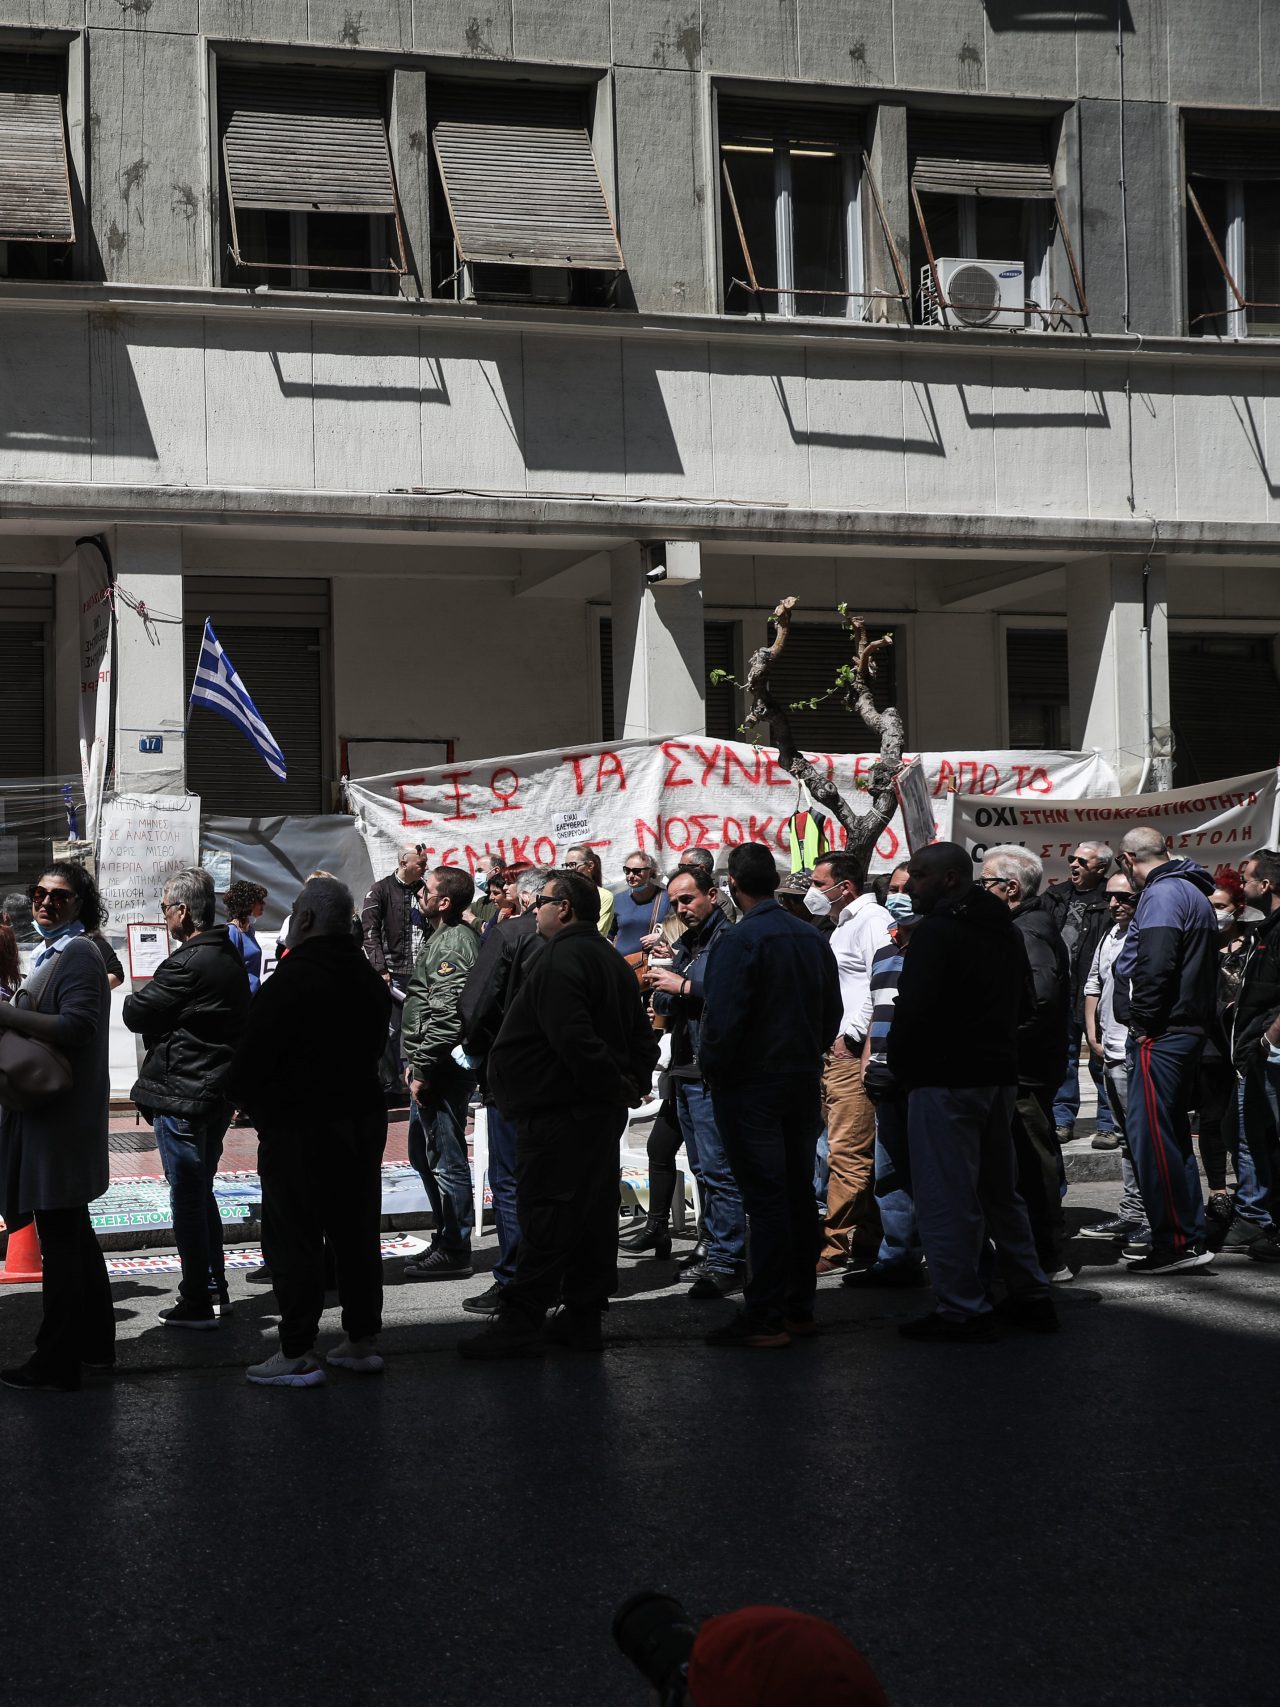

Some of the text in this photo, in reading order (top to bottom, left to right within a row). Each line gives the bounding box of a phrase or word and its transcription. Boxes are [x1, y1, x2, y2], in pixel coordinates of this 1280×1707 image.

[145, 739, 156, 749] 17
[562, 751, 627, 796] ΤΑ
[933, 759, 999, 796] ΑΠΟ
[1011, 764, 1053, 794] ΤΟ
[975, 806, 1018, 828] ΟΧΙ
[1019, 808, 1070, 825] ΣΤΗΝ
[138, 819, 169, 830] ΜΗΝΕΣ
[110, 829, 180, 842] ΣΕ ΑΝΑΣΤΟΛΗ
[110, 846, 175, 857] ΧΩΡΙΣ ΜΙΣΘΟ
[152, 861, 189, 873] ΠΕΙΝΑΣ
